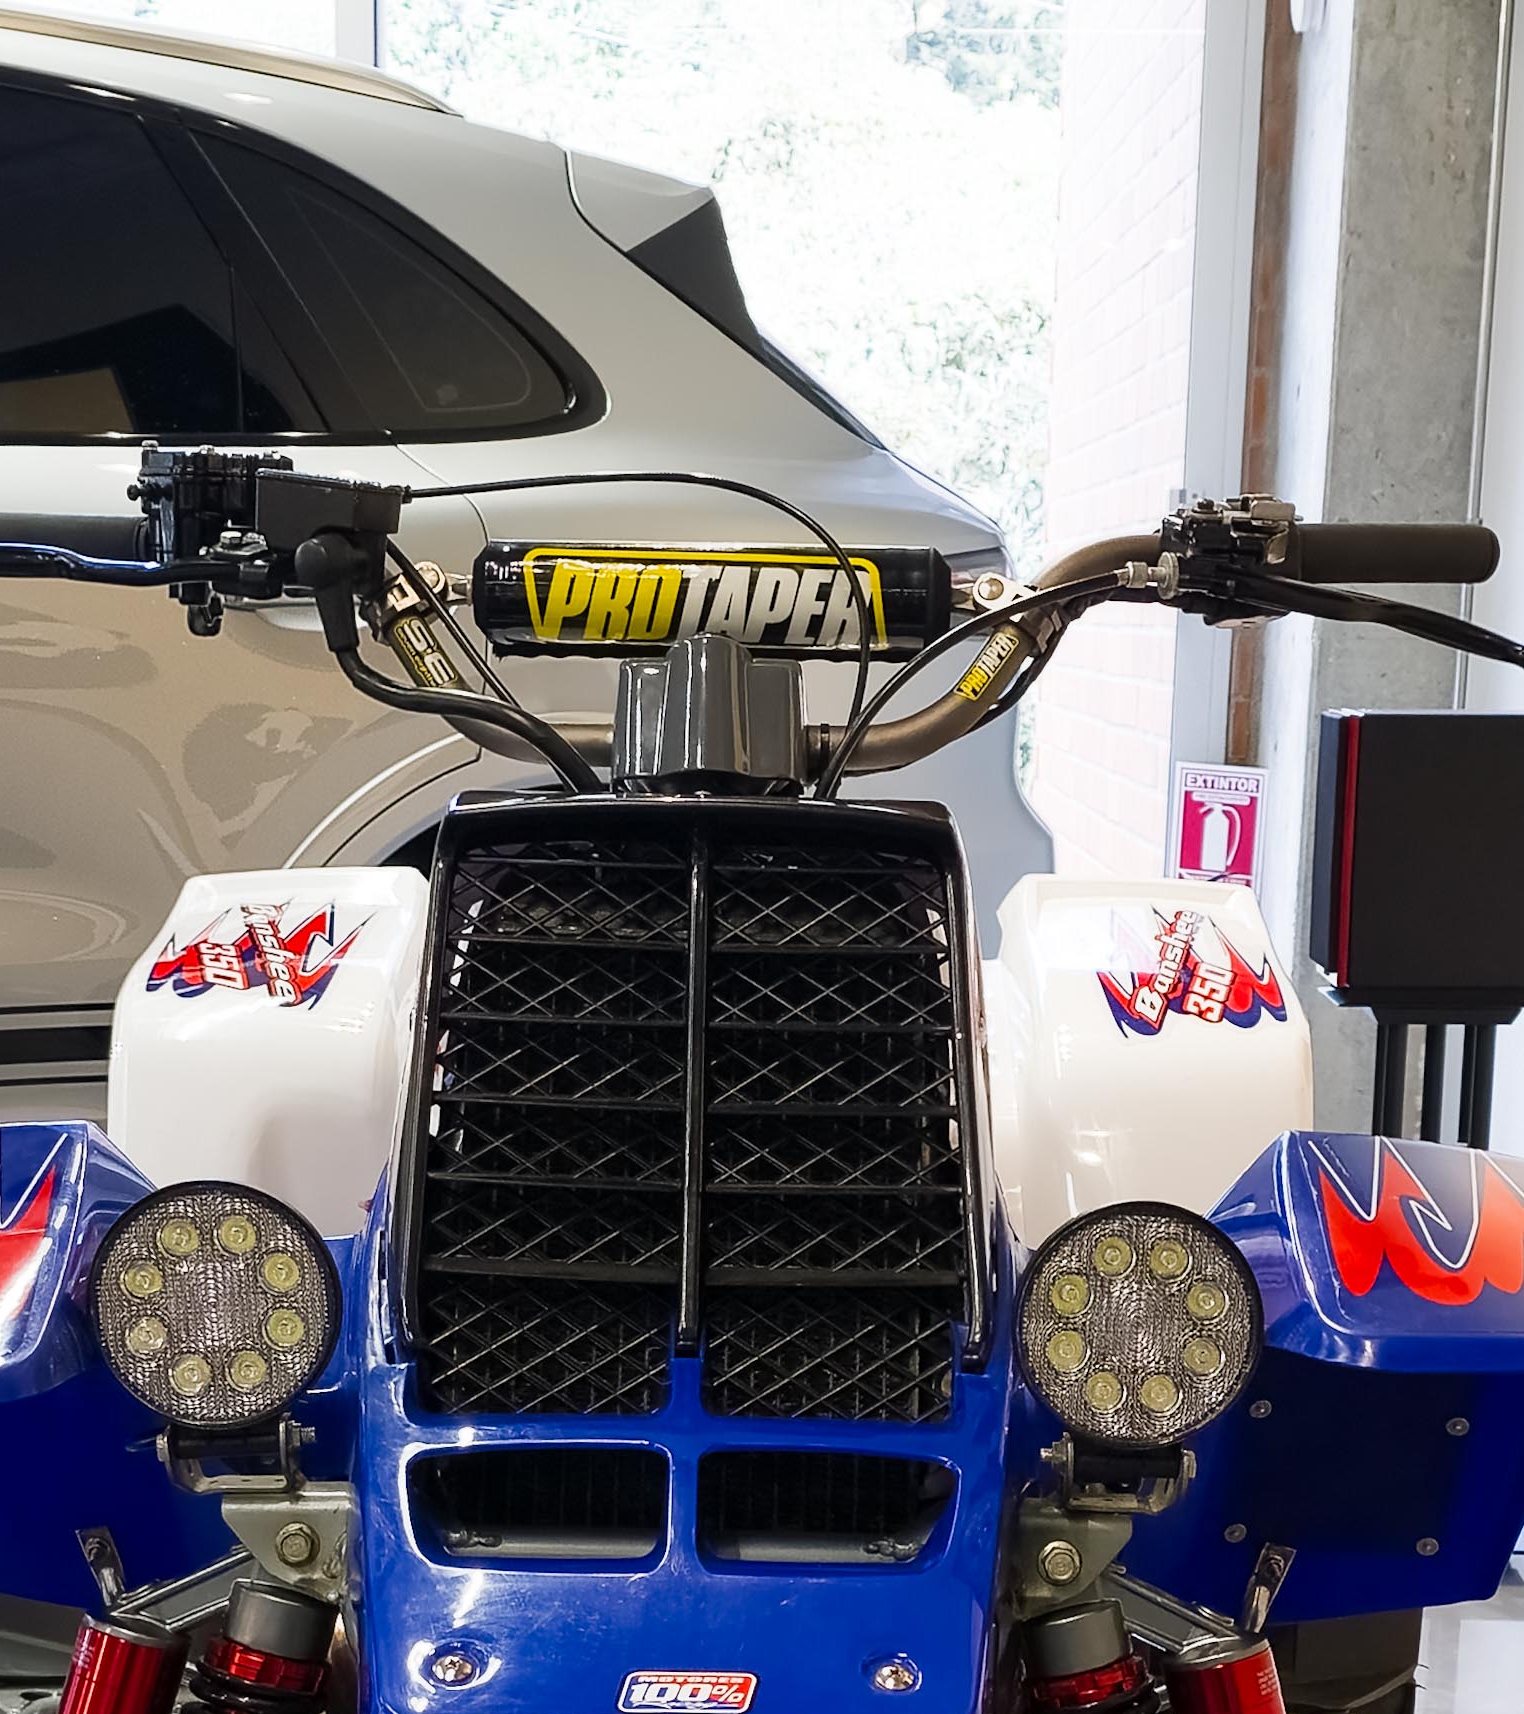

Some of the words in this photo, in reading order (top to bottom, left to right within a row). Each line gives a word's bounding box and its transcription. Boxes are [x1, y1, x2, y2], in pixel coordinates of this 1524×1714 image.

[1186, 774, 1259, 792] EXTINTOR
[198, 942, 245, 989] 350
[1133, 910, 1198, 1023] Banshee
[1185, 963, 1233, 1022] 350
[629, 1683, 745, 1704] 100%
